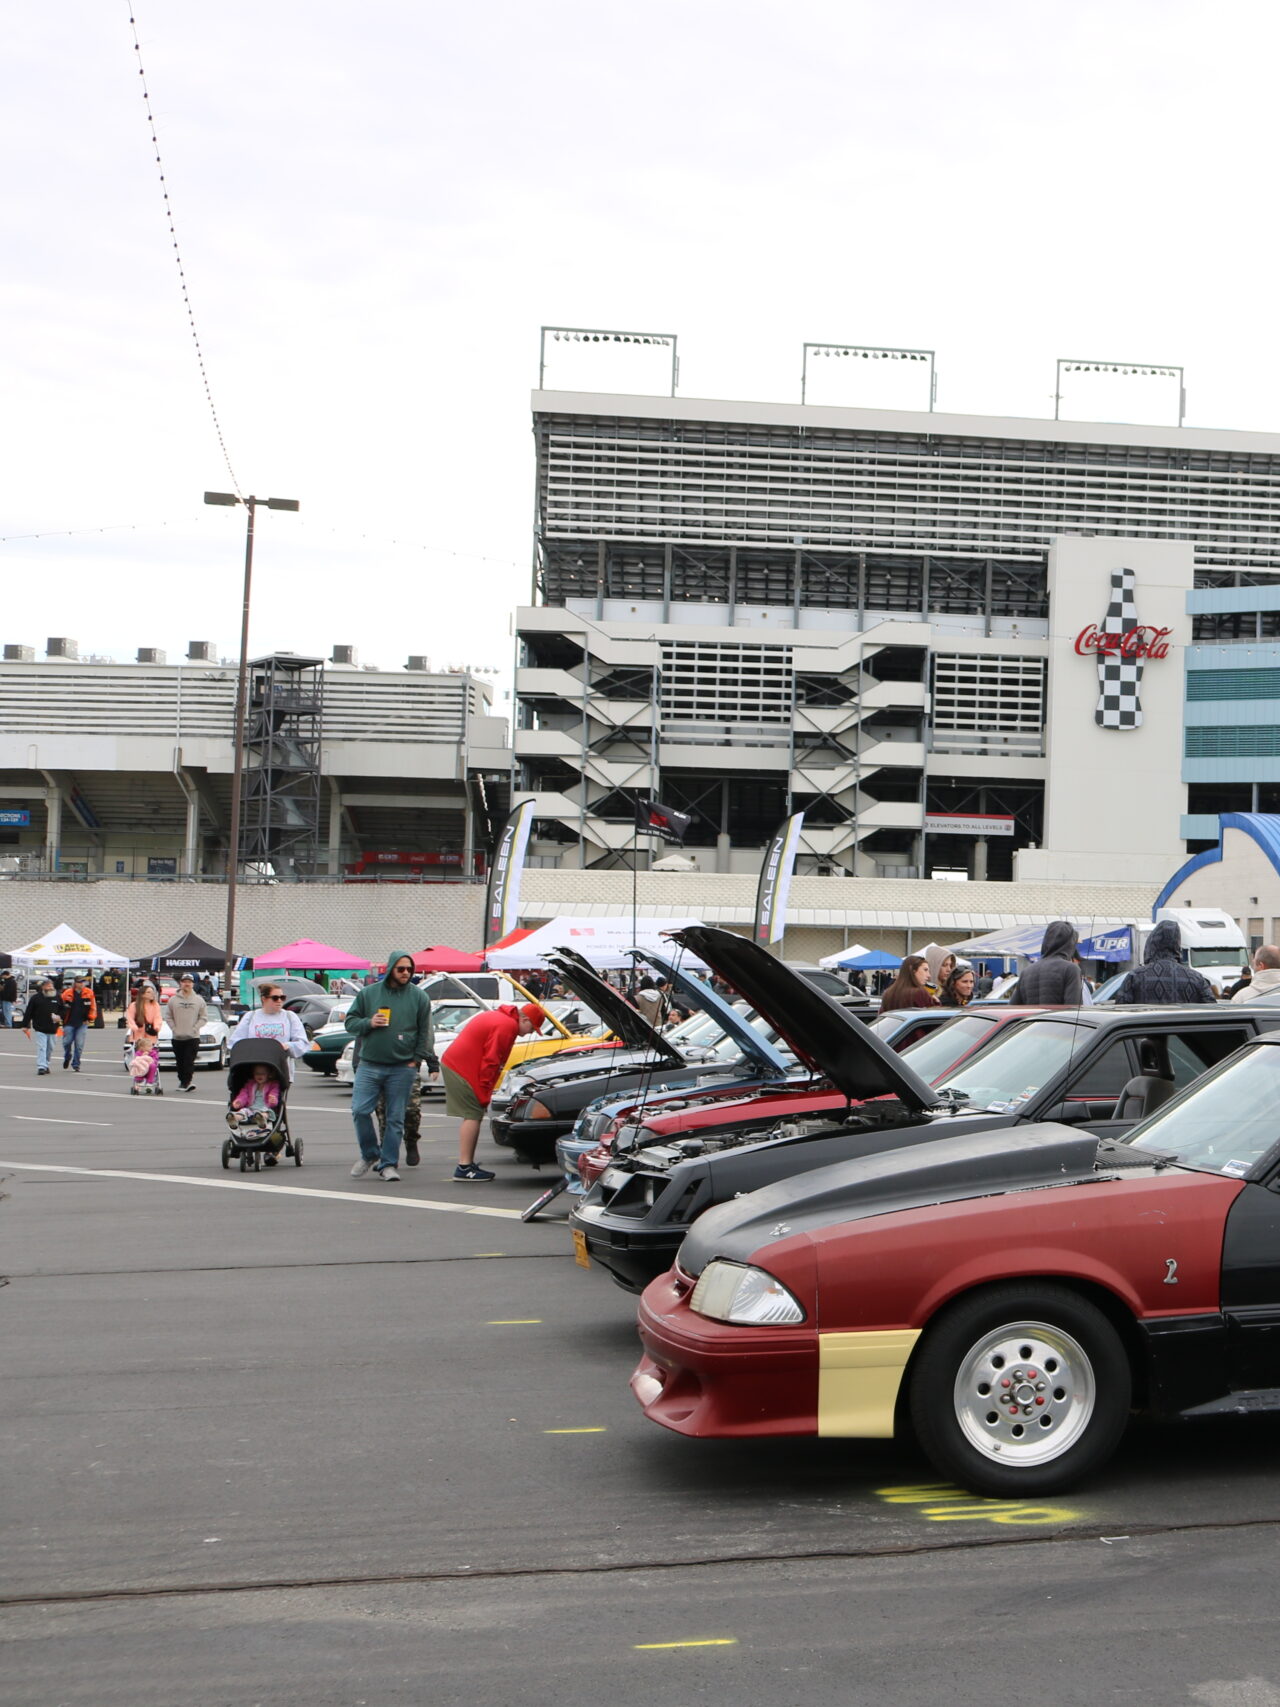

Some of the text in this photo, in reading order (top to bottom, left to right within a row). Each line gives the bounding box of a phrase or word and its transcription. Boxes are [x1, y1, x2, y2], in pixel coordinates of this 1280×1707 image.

[1074, 623, 1174, 659] Coca-Cola
[492, 825, 515, 917] SALEEN
[761, 837, 784, 925] SALEEN
[1092, 936, 1129, 951] UPR
[166, 959, 201, 967] HAGERTY
